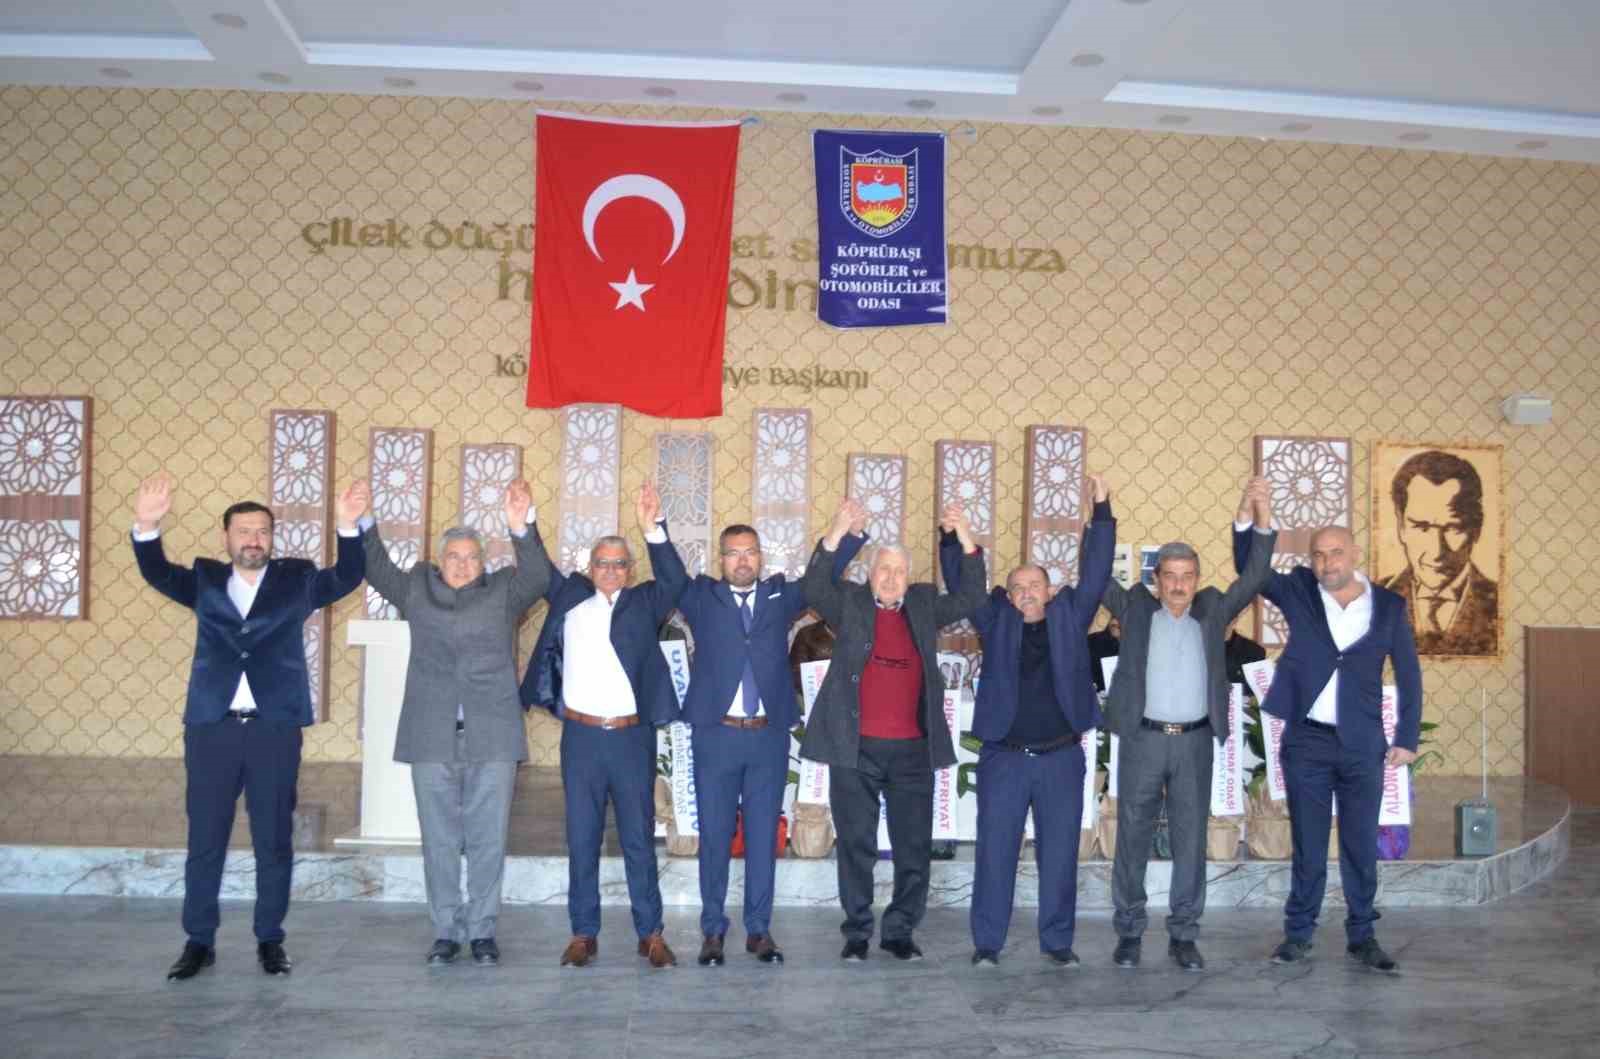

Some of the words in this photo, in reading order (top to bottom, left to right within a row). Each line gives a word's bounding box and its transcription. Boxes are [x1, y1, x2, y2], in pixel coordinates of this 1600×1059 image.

[837, 243, 921, 262] KÖPRÜBAŞI
[830, 261, 908, 279] ŞOFÖRLER
[912, 267, 928, 277] ve
[819, 279, 941, 295] OTOMOBİLCİLER
[857, 298, 901, 310] ODASI
[671, 648, 687, 700] UYA
[938, 767, 951, 831] AFRİYAT
